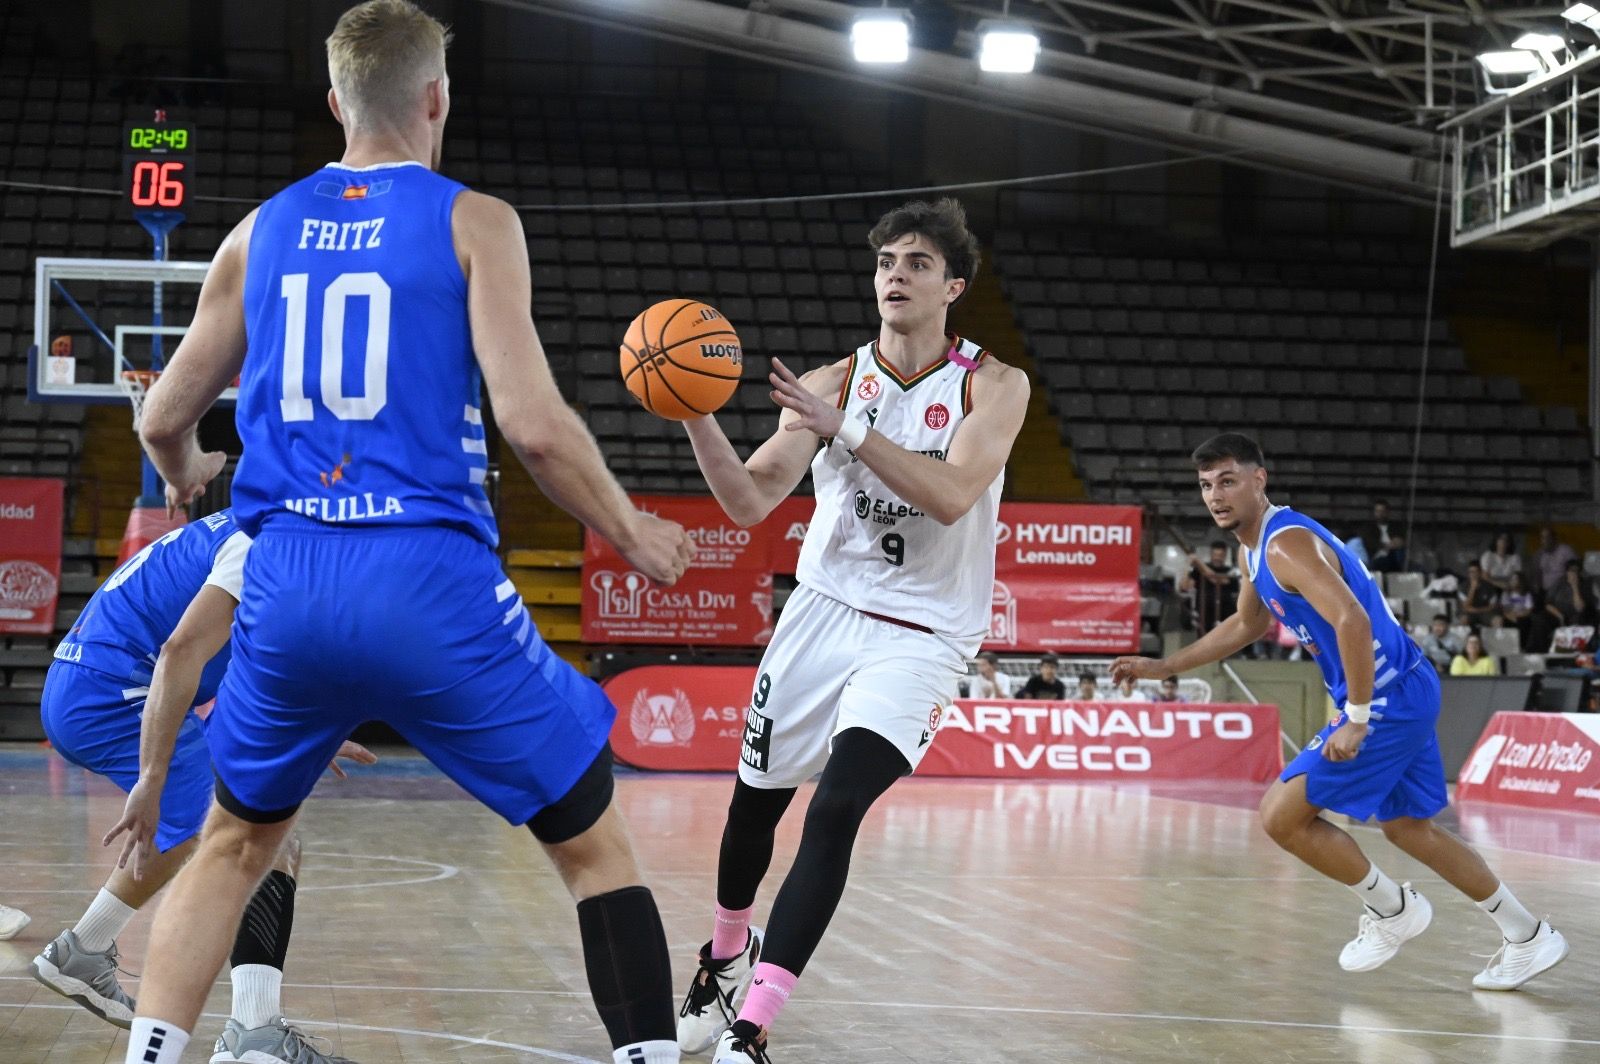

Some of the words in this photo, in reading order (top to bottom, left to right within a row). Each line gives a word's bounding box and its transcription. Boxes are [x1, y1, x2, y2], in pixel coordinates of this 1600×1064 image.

[131, 128, 187, 148] 02:49
[132, 162, 184, 207] 06
[298, 217, 386, 251] FRITZ
[280, 272, 391, 422] 10
[700, 343, 742, 366] lson
[873, 498, 925, 518] E.Lec
[873, 515, 896, 526] LEÓN
[686, 524, 751, 546] etelco
[1016, 523, 1132, 545] HYUNDAI
[881, 533, 905, 567] 9
[1016, 548, 1097, 565] Lemauto
[646, 588, 693, 608] CASA
[698, 589, 736, 609] DIVI
[754, 672, 771, 710] 9
[937, 705, 1253, 739] ARTINAUTO
[994, 743, 1152, 772] IVECO
